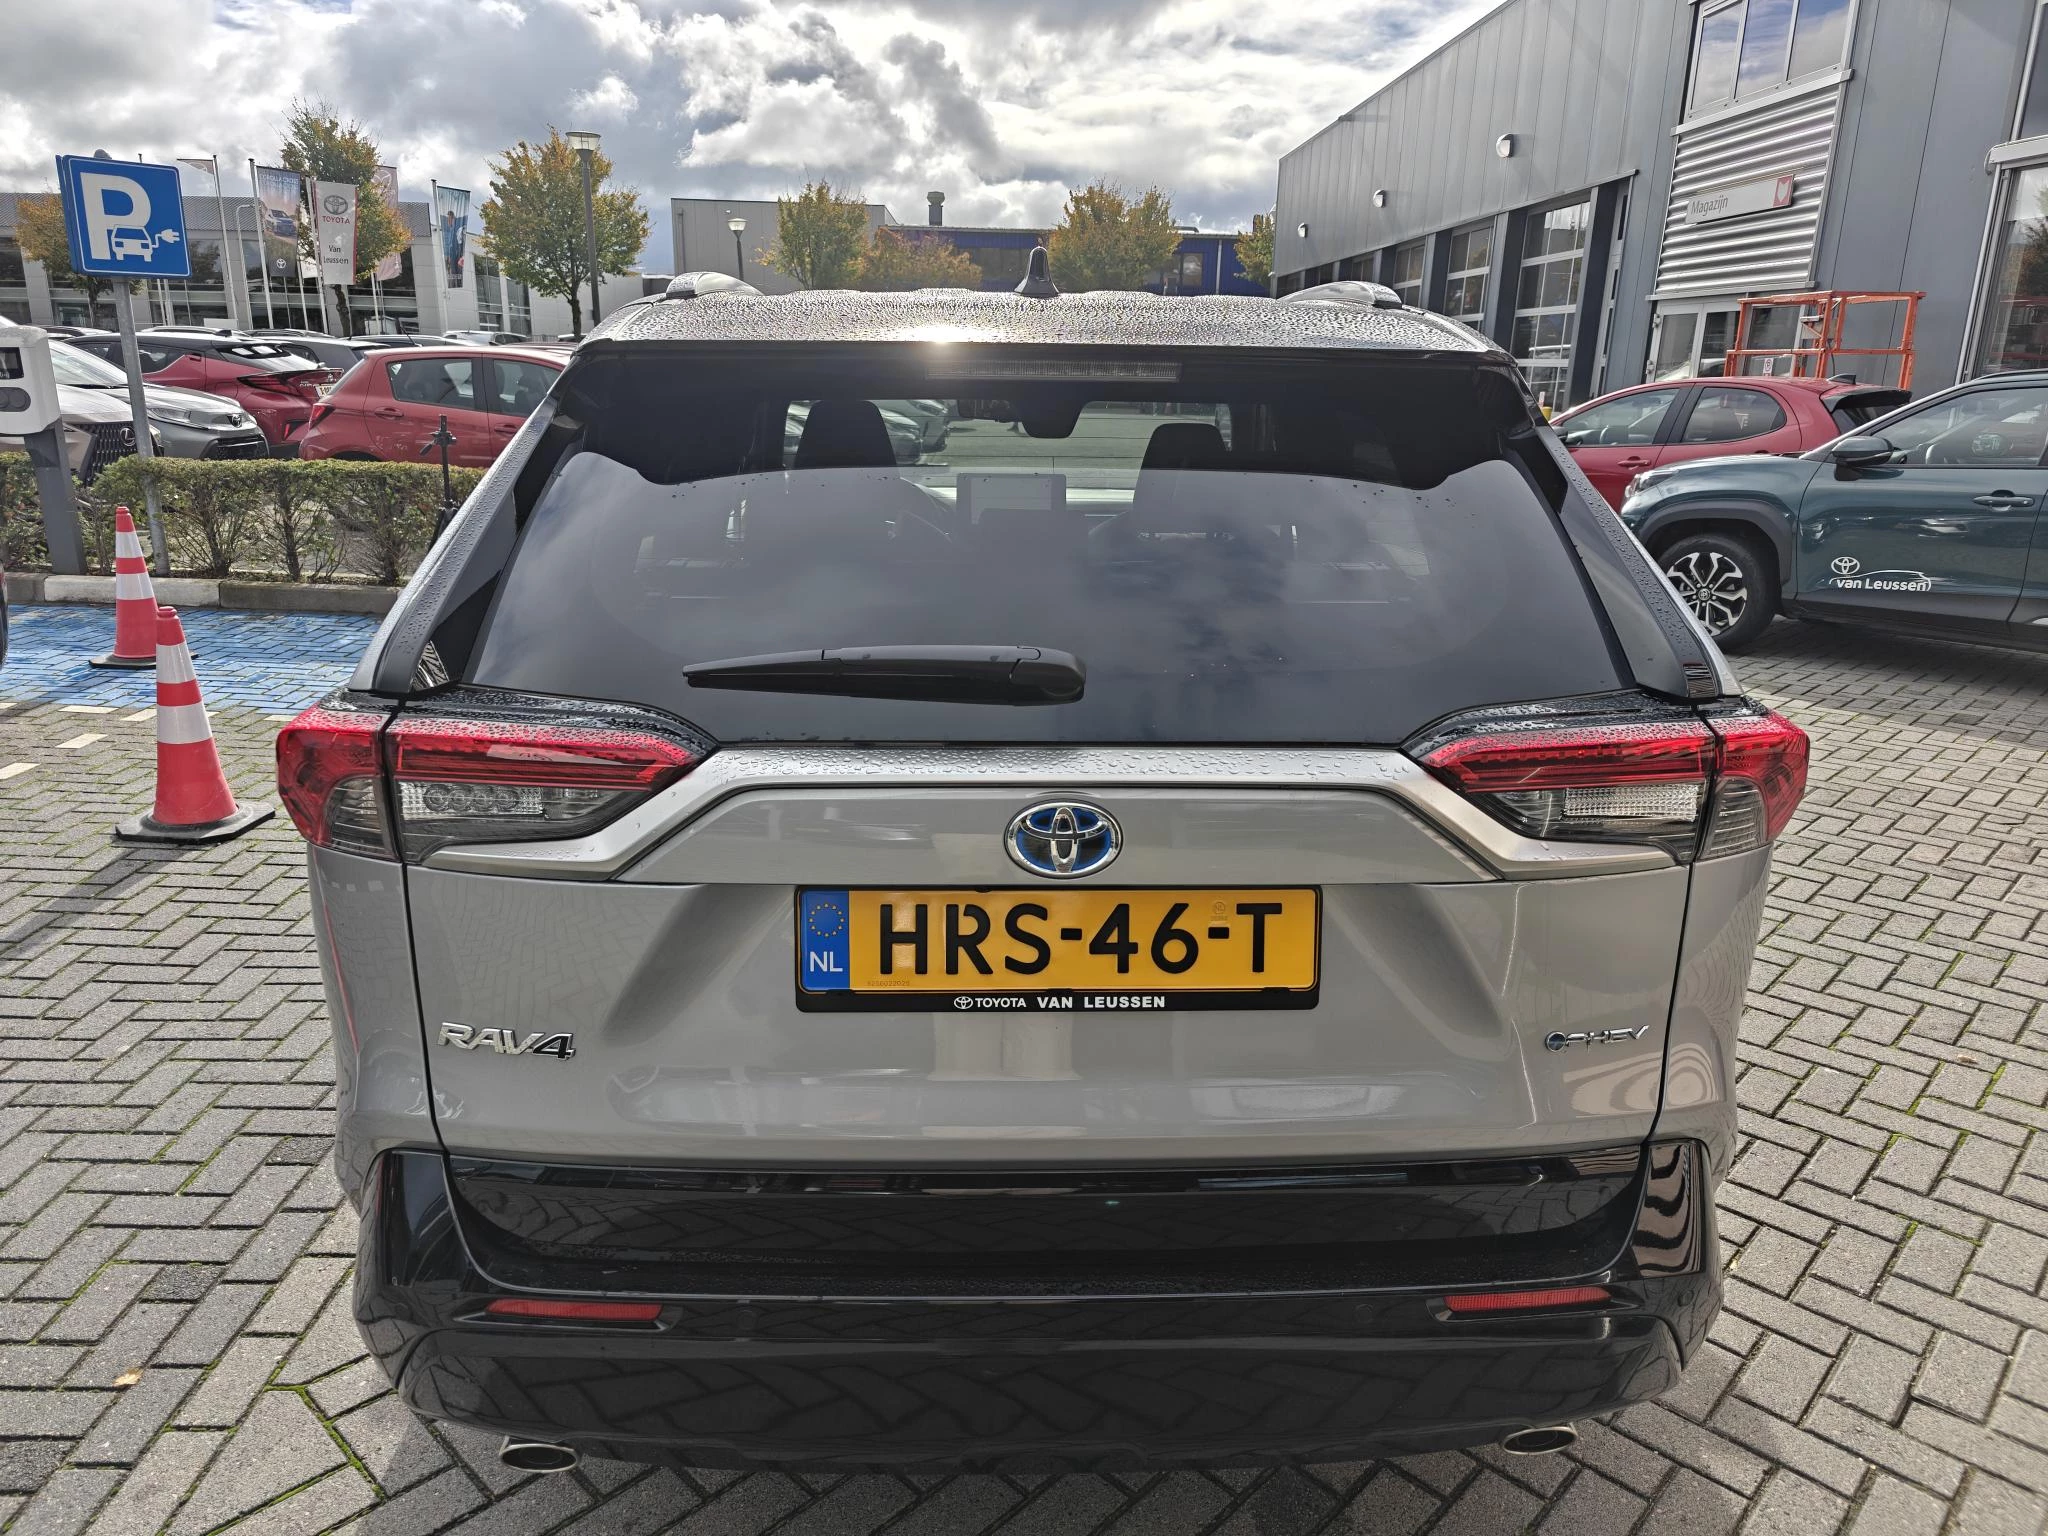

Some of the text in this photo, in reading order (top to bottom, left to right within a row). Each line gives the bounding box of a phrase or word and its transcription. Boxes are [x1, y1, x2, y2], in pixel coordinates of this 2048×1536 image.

[80, 172, 151, 260] P
[1691, 195, 1729, 216] Magazijn
[322, 215, 350, 225] TOYOTA
[328, 244, 341, 253] Van
[1837, 578, 1927, 592] van Leussen
[809, 902, 1283, 975] NL HRS-46-T
[975, 996, 1165, 1009] TOYOTA VAN LEUSSEN
[437, 1022, 577, 1061] RAV4
[1566, 1025, 1650, 1047] PHEV
